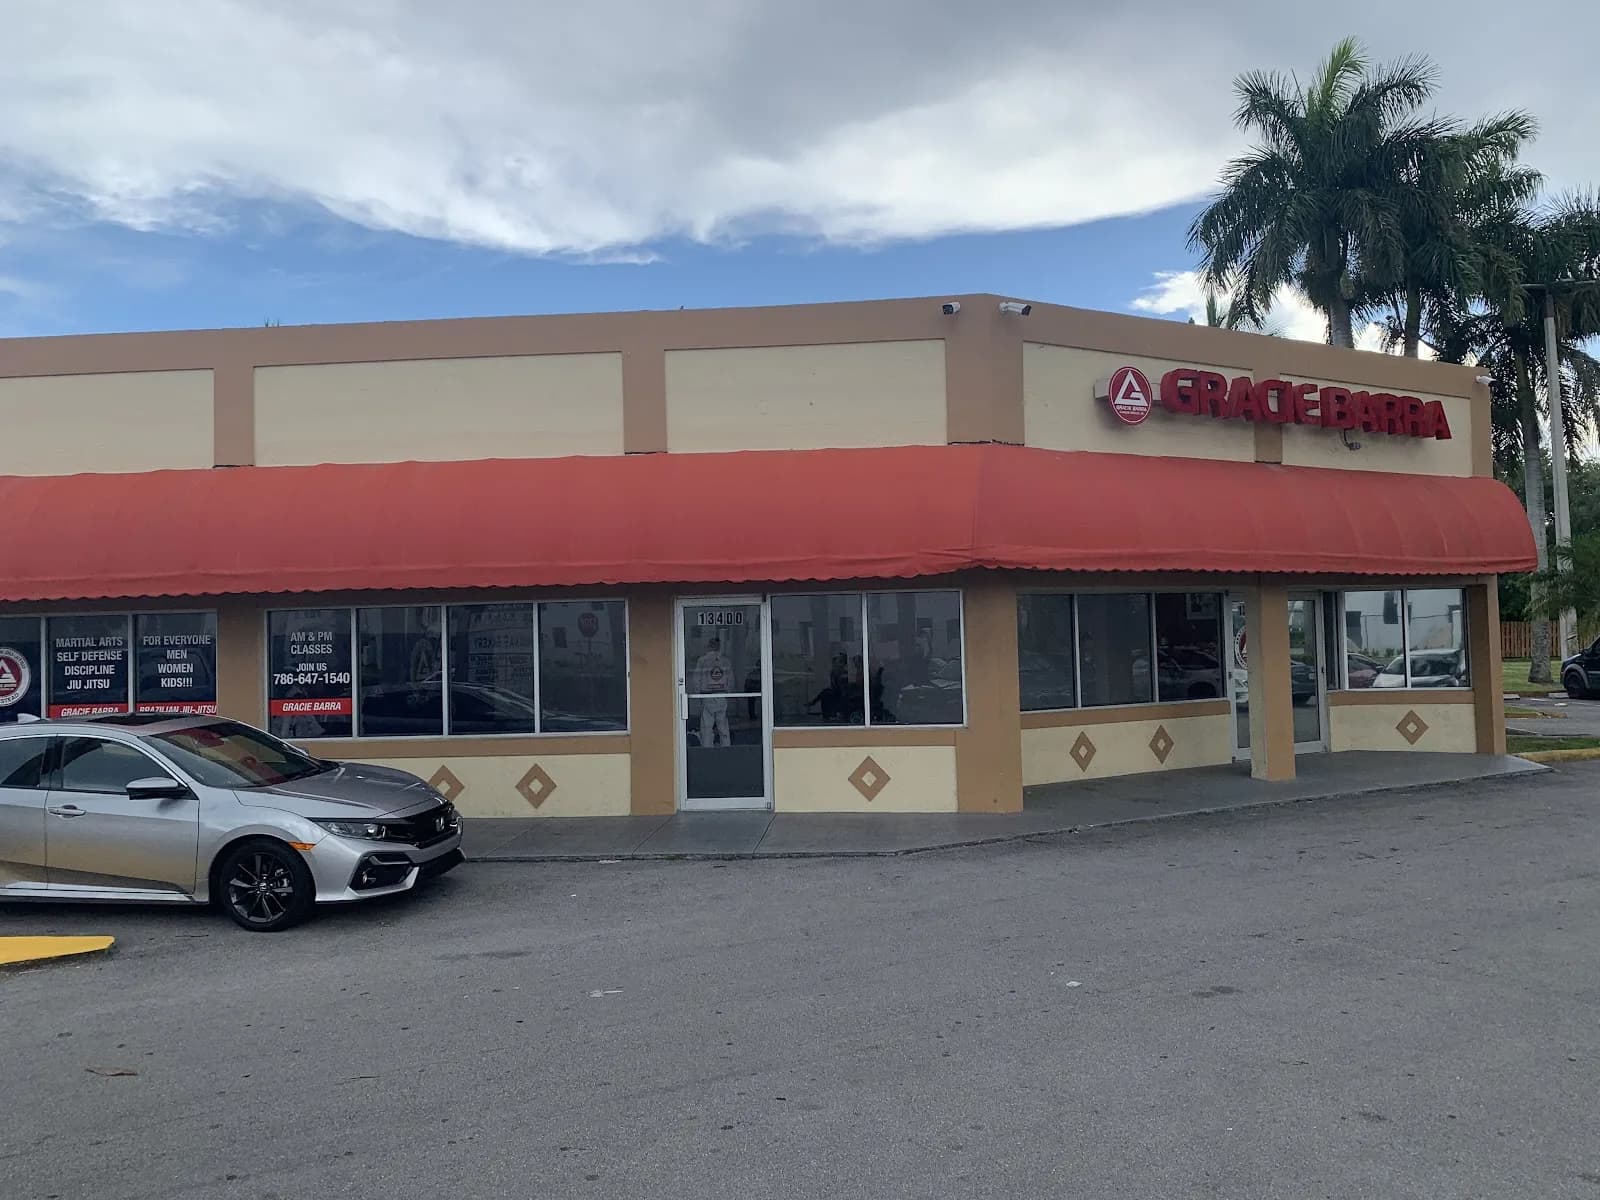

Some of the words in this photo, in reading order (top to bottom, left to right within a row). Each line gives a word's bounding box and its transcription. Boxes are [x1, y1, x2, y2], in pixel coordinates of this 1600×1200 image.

[1160, 368, 1320, 425] GRACIE
[1320, 385, 1453, 440] BARRA
[699, 611, 743, 625] 13400
[56, 637, 97, 648] MARTIAL
[98, 636, 123, 647] ARTS
[143, 635, 161, 646] FOR
[163, 634, 212, 645] EVERYONE
[290, 632, 306, 642] AM
[307, 632, 316, 641] &
[318, 631, 333, 641] PM
[166, 649, 188, 660] MEN
[290, 644, 333, 655] CLASSES
[57, 651, 79, 662] SELF
[81, 650, 123, 661] DEFENSE
[64, 665, 116, 676] DISCIPLINE
[157, 663, 194, 674] WOMEN
[296, 663, 315, 672] JOIN
[316, 662, 328, 672] US
[160, 677, 193, 688] KIDS!!!
[273, 672, 350, 685] 786-647-1540
[66, 680, 82, 690] JIU
[83, 679, 110, 690] JITSU
[282, 703, 312, 712] GRACIE
[313, 702, 341, 711] BARRA
